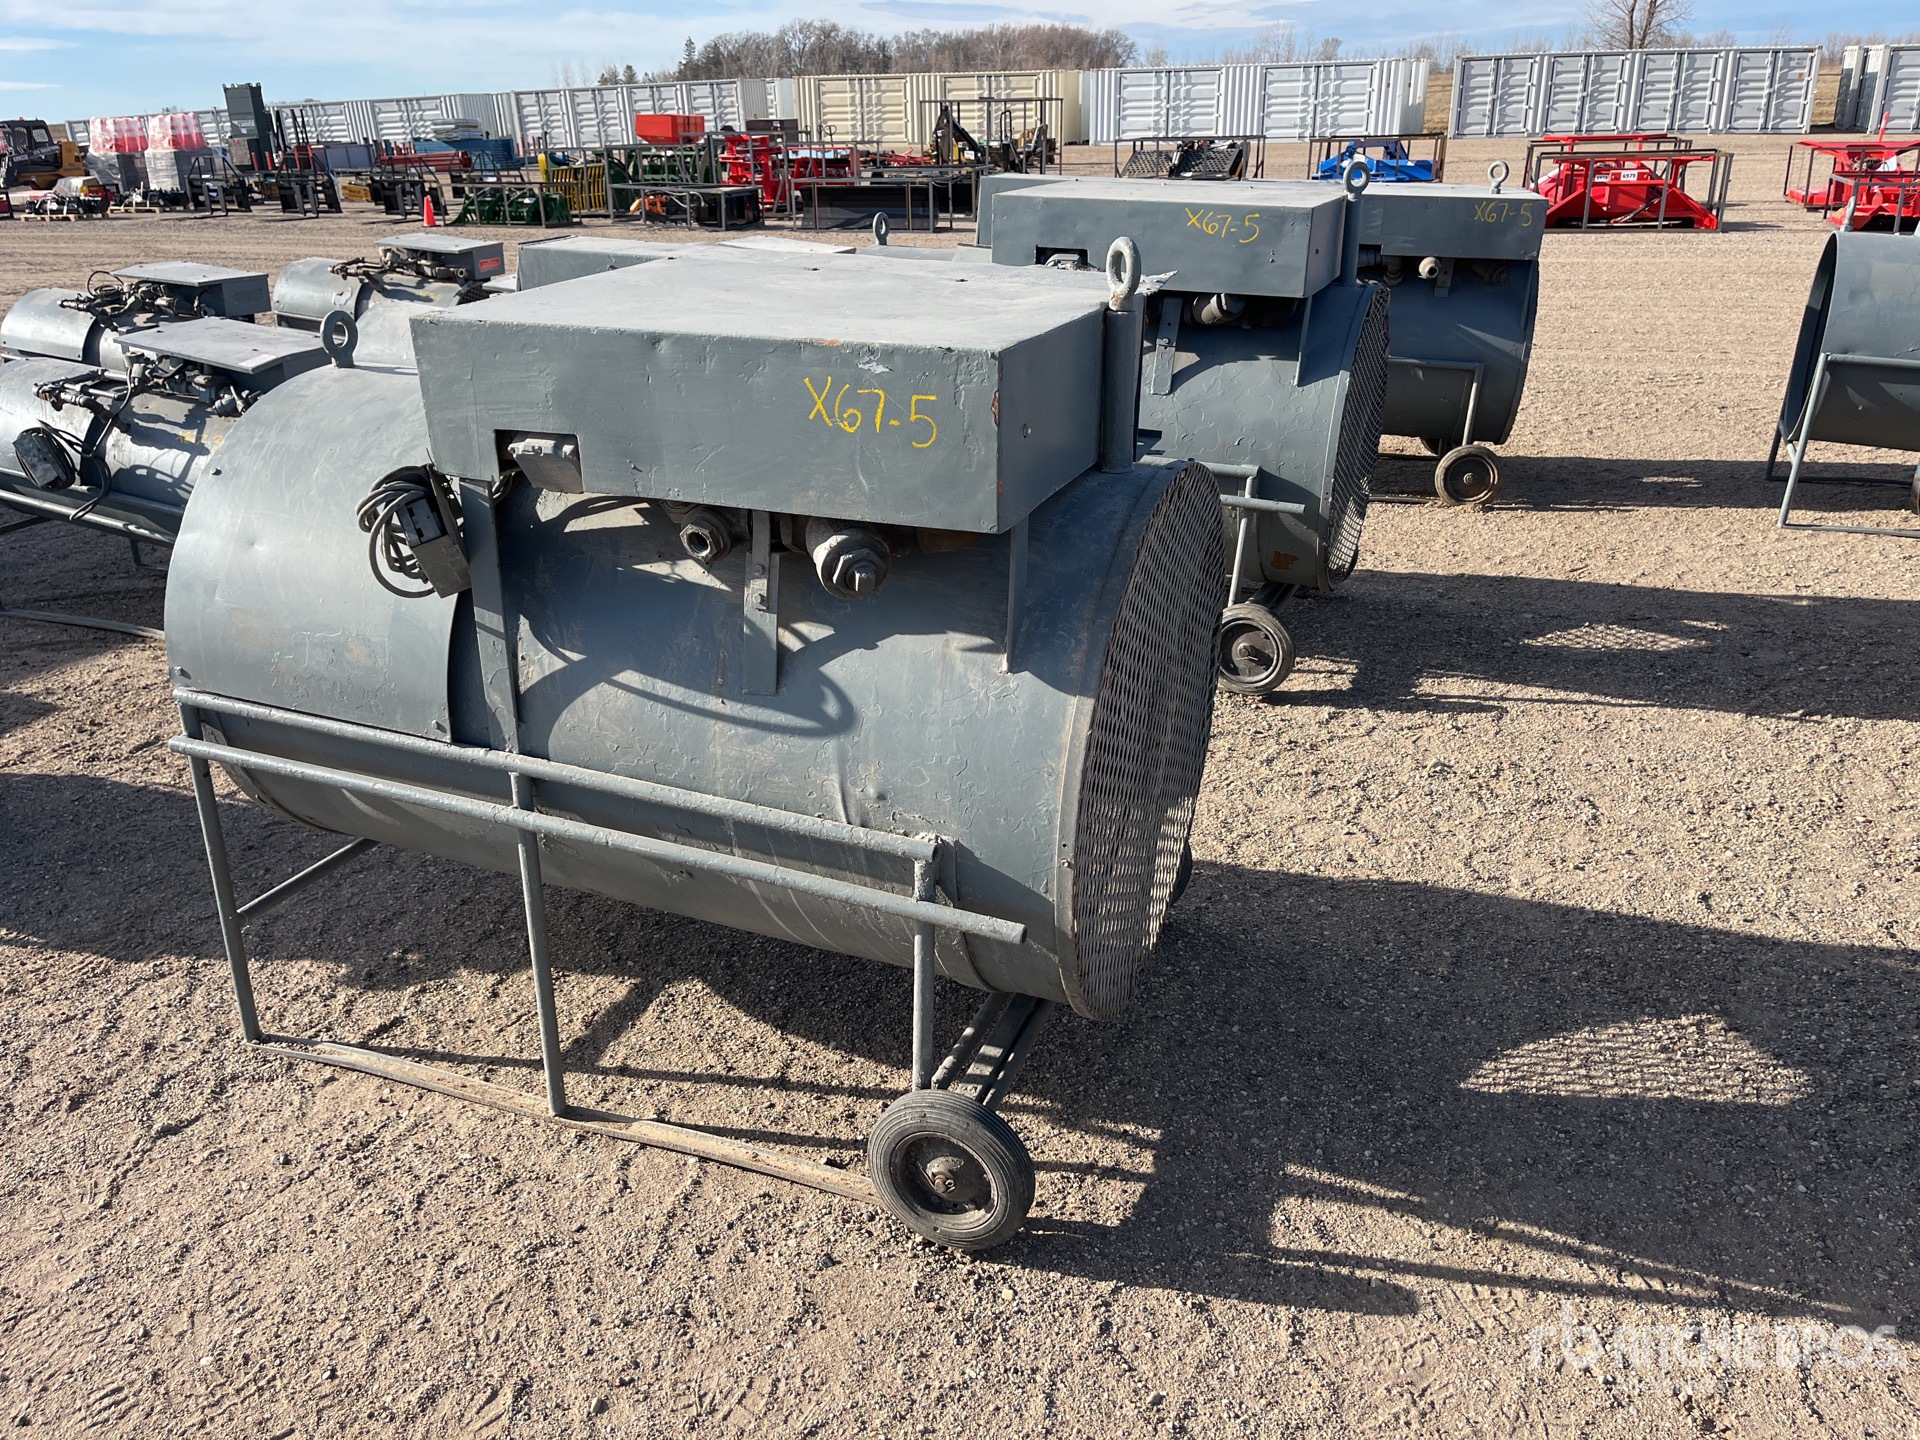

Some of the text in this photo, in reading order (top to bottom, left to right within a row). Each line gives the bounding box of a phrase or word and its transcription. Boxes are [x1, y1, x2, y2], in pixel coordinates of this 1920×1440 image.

[1185, 208, 1260, 243] X67-5
[1474, 201, 1532, 227] X67-5
[804, 376, 938, 448] X67-5
